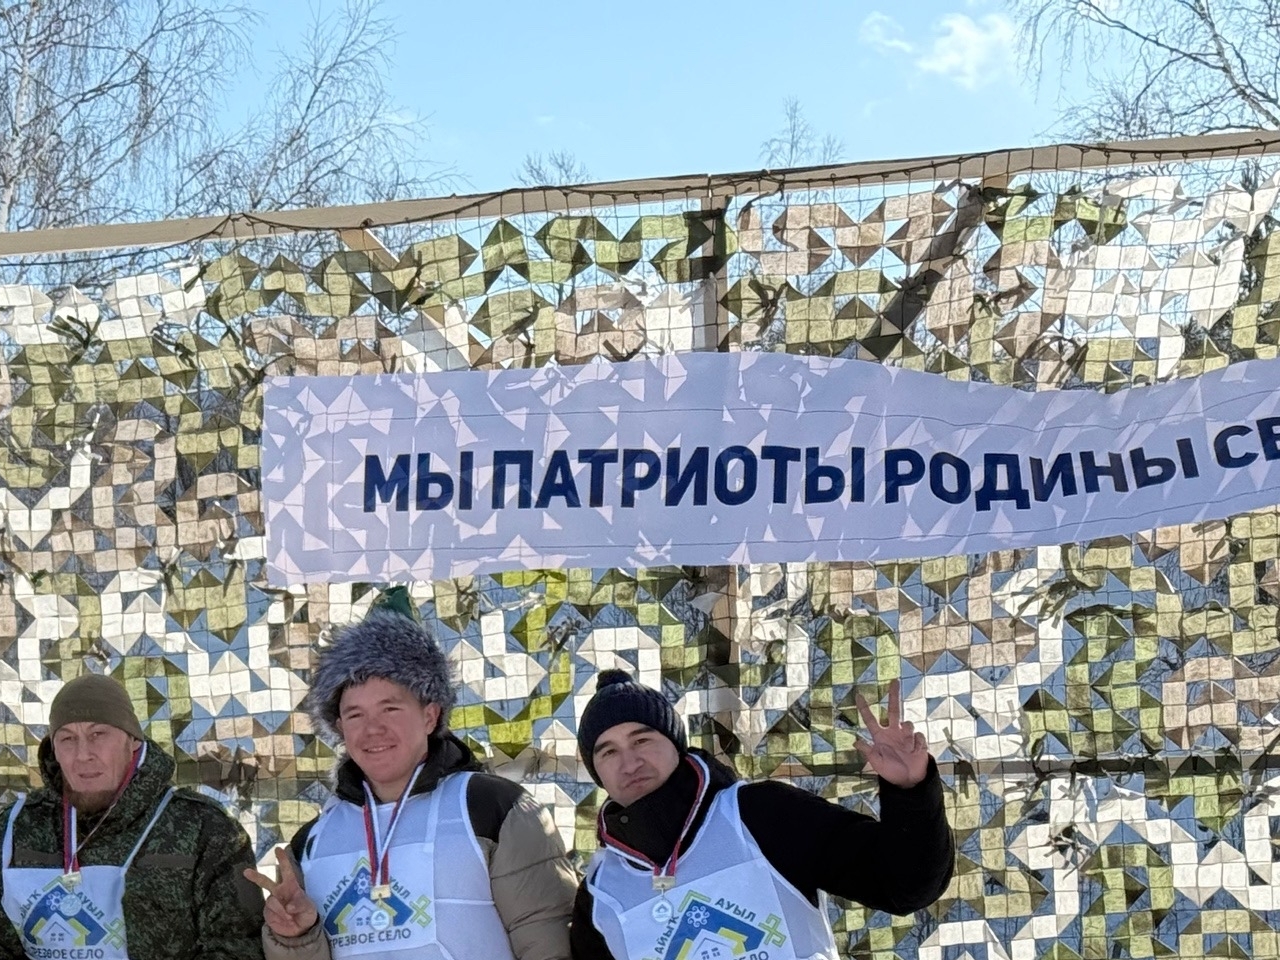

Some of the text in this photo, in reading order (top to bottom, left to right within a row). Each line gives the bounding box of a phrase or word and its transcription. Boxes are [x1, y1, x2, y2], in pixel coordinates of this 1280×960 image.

[363, 450, 474, 513] МЫ
[491, 445, 866, 510] ПАТРИОТЫ
[884, 437, 1200, 512] РОДИНЫ
[714, 896, 757, 923] АУЫЛ
[377, 927, 412, 942] СЕЛО
[70, 948, 104, 960] СЕЛО
